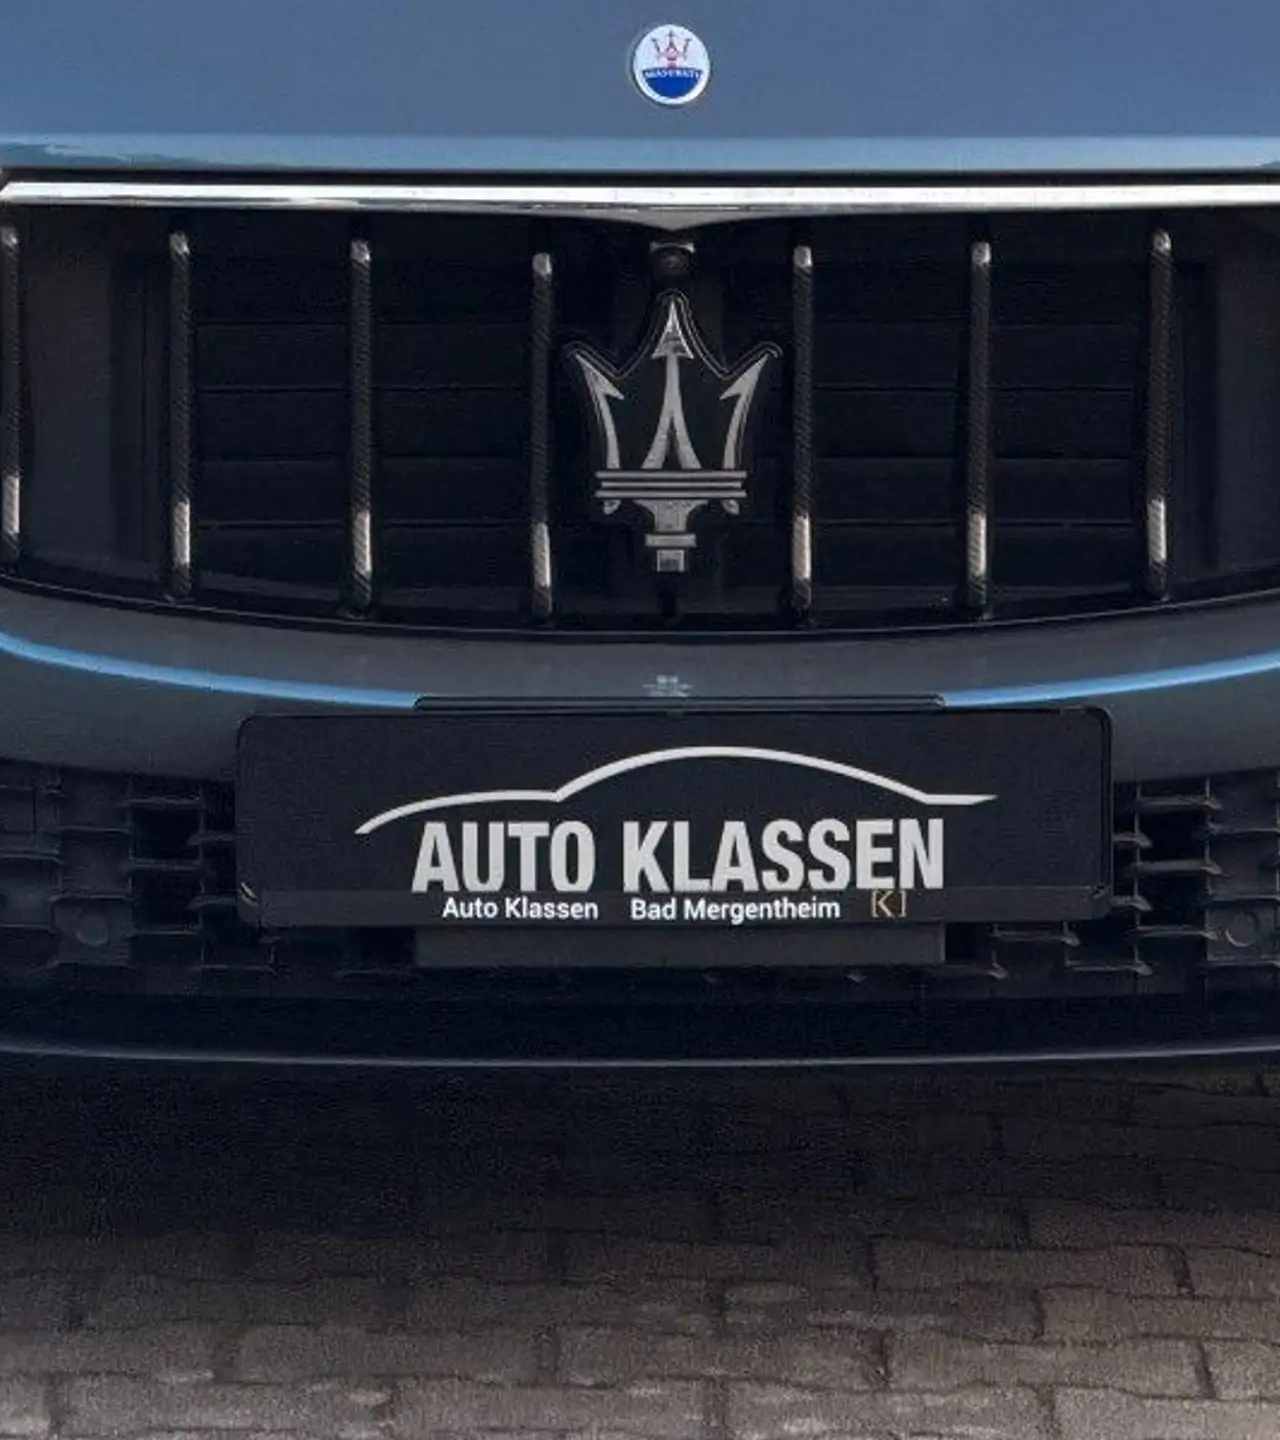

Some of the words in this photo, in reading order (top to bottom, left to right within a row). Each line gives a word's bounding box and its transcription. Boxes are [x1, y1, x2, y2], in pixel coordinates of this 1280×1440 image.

[411, 821, 596, 893] AUTO
[622, 818, 944, 893] KLASSEN
[442, 897, 499, 920] Auto
[505, 896, 598, 920] Klassen
[630, 896, 676, 920] Bad
[683, 896, 841, 925] Mergentheim
